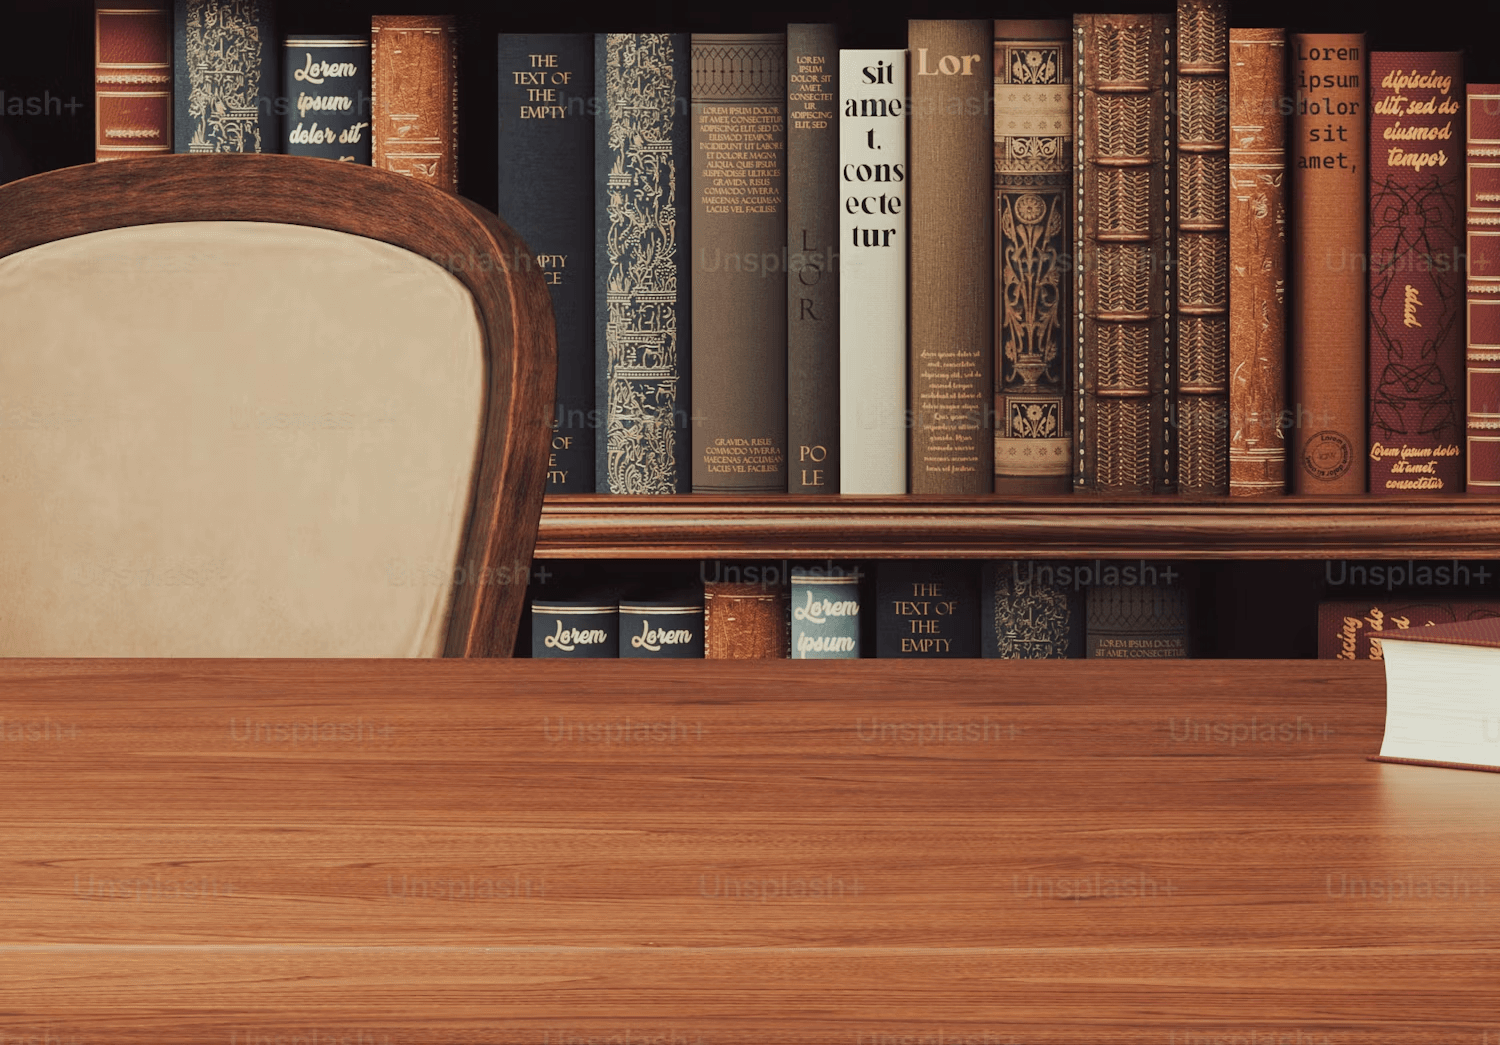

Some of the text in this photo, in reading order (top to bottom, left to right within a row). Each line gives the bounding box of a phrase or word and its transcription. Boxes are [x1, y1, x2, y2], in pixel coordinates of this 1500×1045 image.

[294, 53, 356, 84] Lorem
[916, 48, 980, 79] Lor
[1381, 70, 1451, 94] dipiscing
[297, 92, 352, 117] ipsum
[1375, 95, 1459, 117] elit, sed do
[289, 122, 368, 144] dolor sit
[1383, 121, 1451, 140] eiusmod
[1388, 147, 1448, 172] tempor
[1404, 285, 1423, 327] sdad
[914, 584, 941, 596] THE
[792, 591, 858, 625] Lorem
[894, 602, 953, 615] TEXT OF
[545, 620, 607, 651] Lorem
[632, 620, 692, 651] Lorem
[909, 620, 939, 633] THE
[797, 631, 855, 657] ipsum
[902, 639, 948, 652] EMPTY
